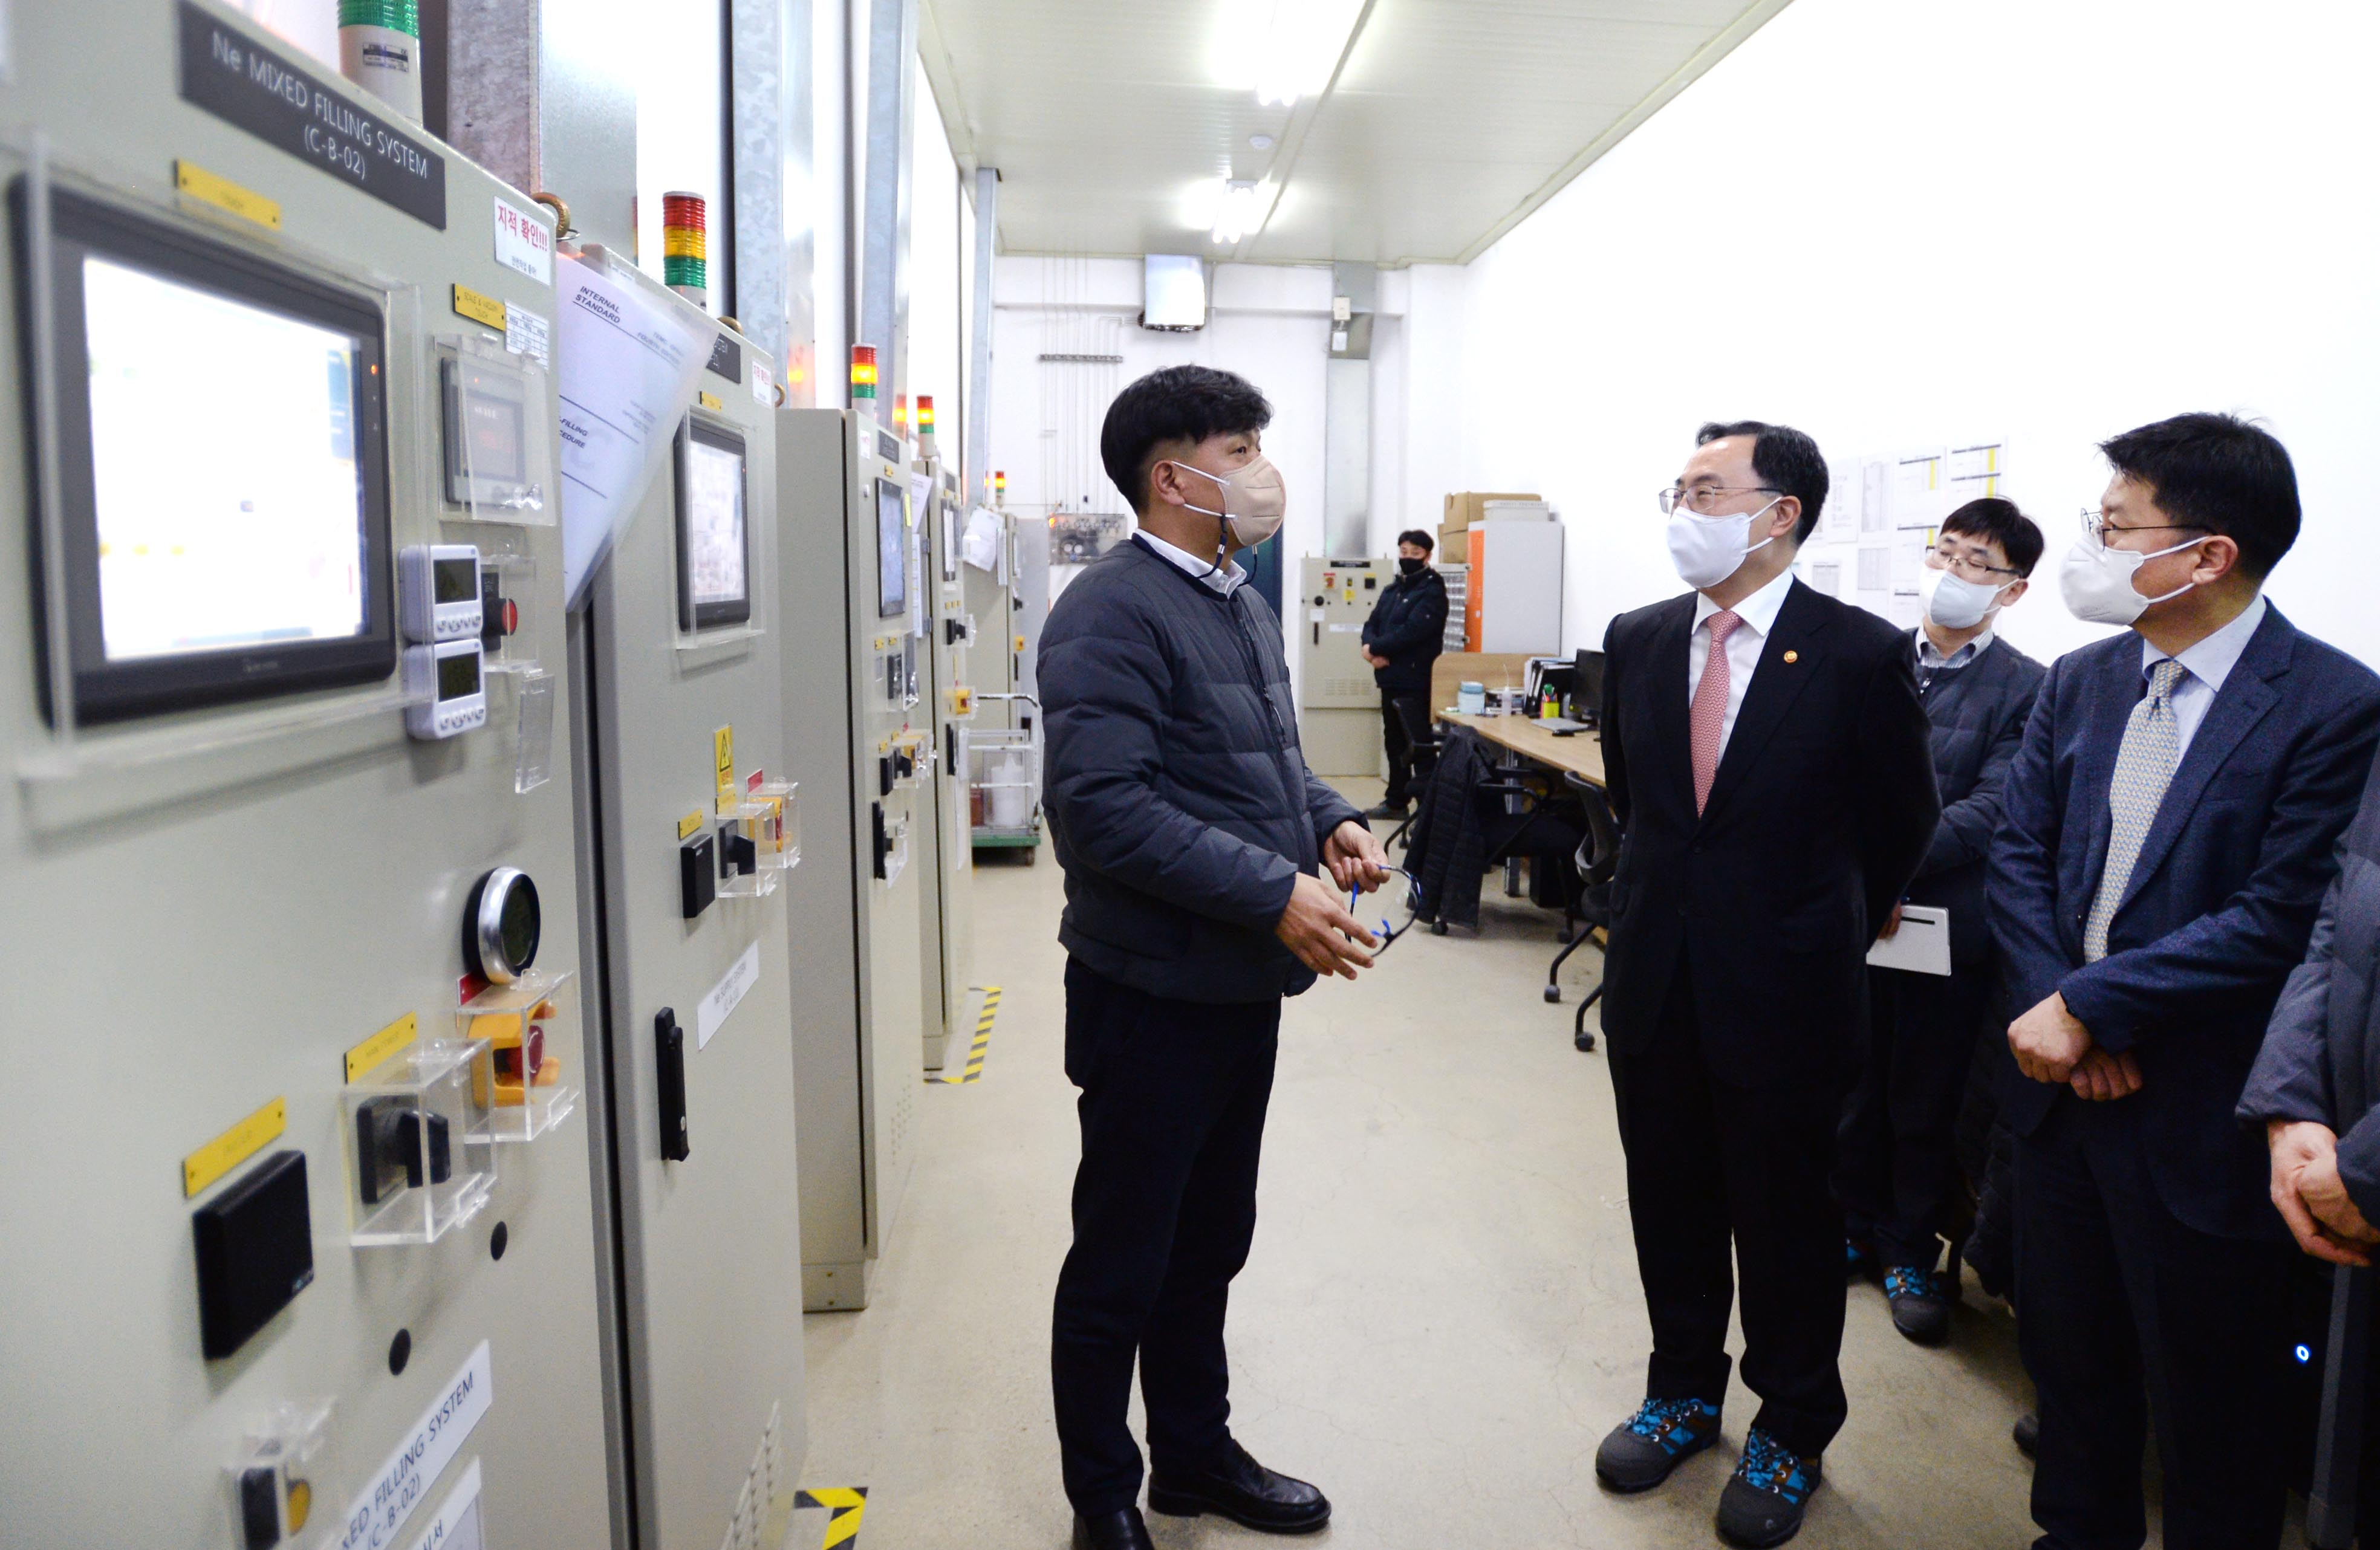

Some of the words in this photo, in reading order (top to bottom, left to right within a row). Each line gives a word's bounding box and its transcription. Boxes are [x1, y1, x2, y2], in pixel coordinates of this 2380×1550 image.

[213, 30, 241, 71] Ne
[249, 52, 308, 108] MIXED
[314, 92, 371, 146] FILLING
[377, 130, 427, 179] SYSTEM
[305, 124, 365, 180] (C-B-02)
[498, 205, 517, 237] 지적
[521, 218, 547, 251] 확인!!!
[575, 294, 621, 324] STANDARD
[580, 285, 620, 314] INTERNAL
[375, 1434, 425, 1512] FILLING
[428, 1371, 473, 1443] SYSTEM
